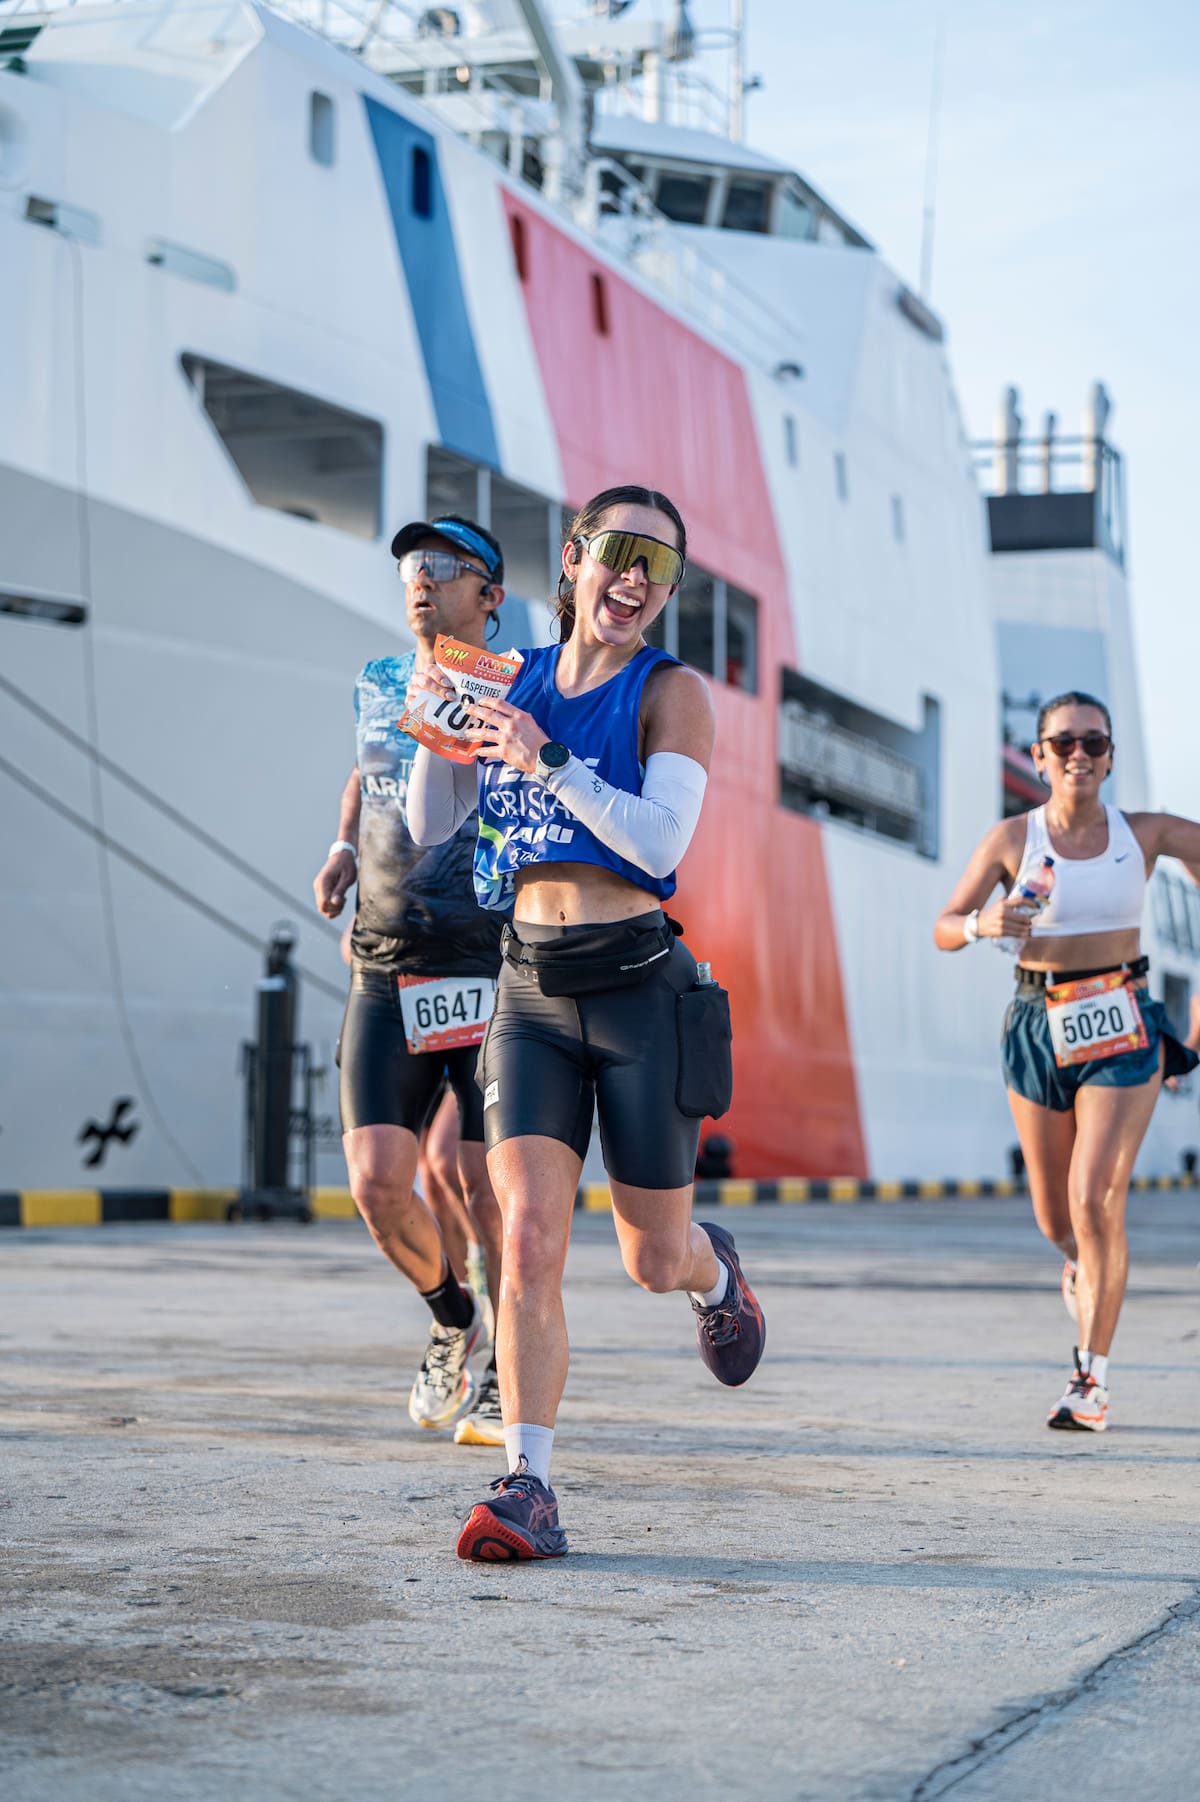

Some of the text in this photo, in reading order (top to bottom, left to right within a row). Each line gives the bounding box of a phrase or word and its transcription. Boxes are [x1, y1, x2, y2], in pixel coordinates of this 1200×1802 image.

[442, 647, 470, 667] 21K
[461, 678, 501, 698] LASPETITES
[486, 786, 583, 822] CRISTA
[415, 987, 483, 1029] 6647
[1062, 1005, 1124, 1044] 5020
